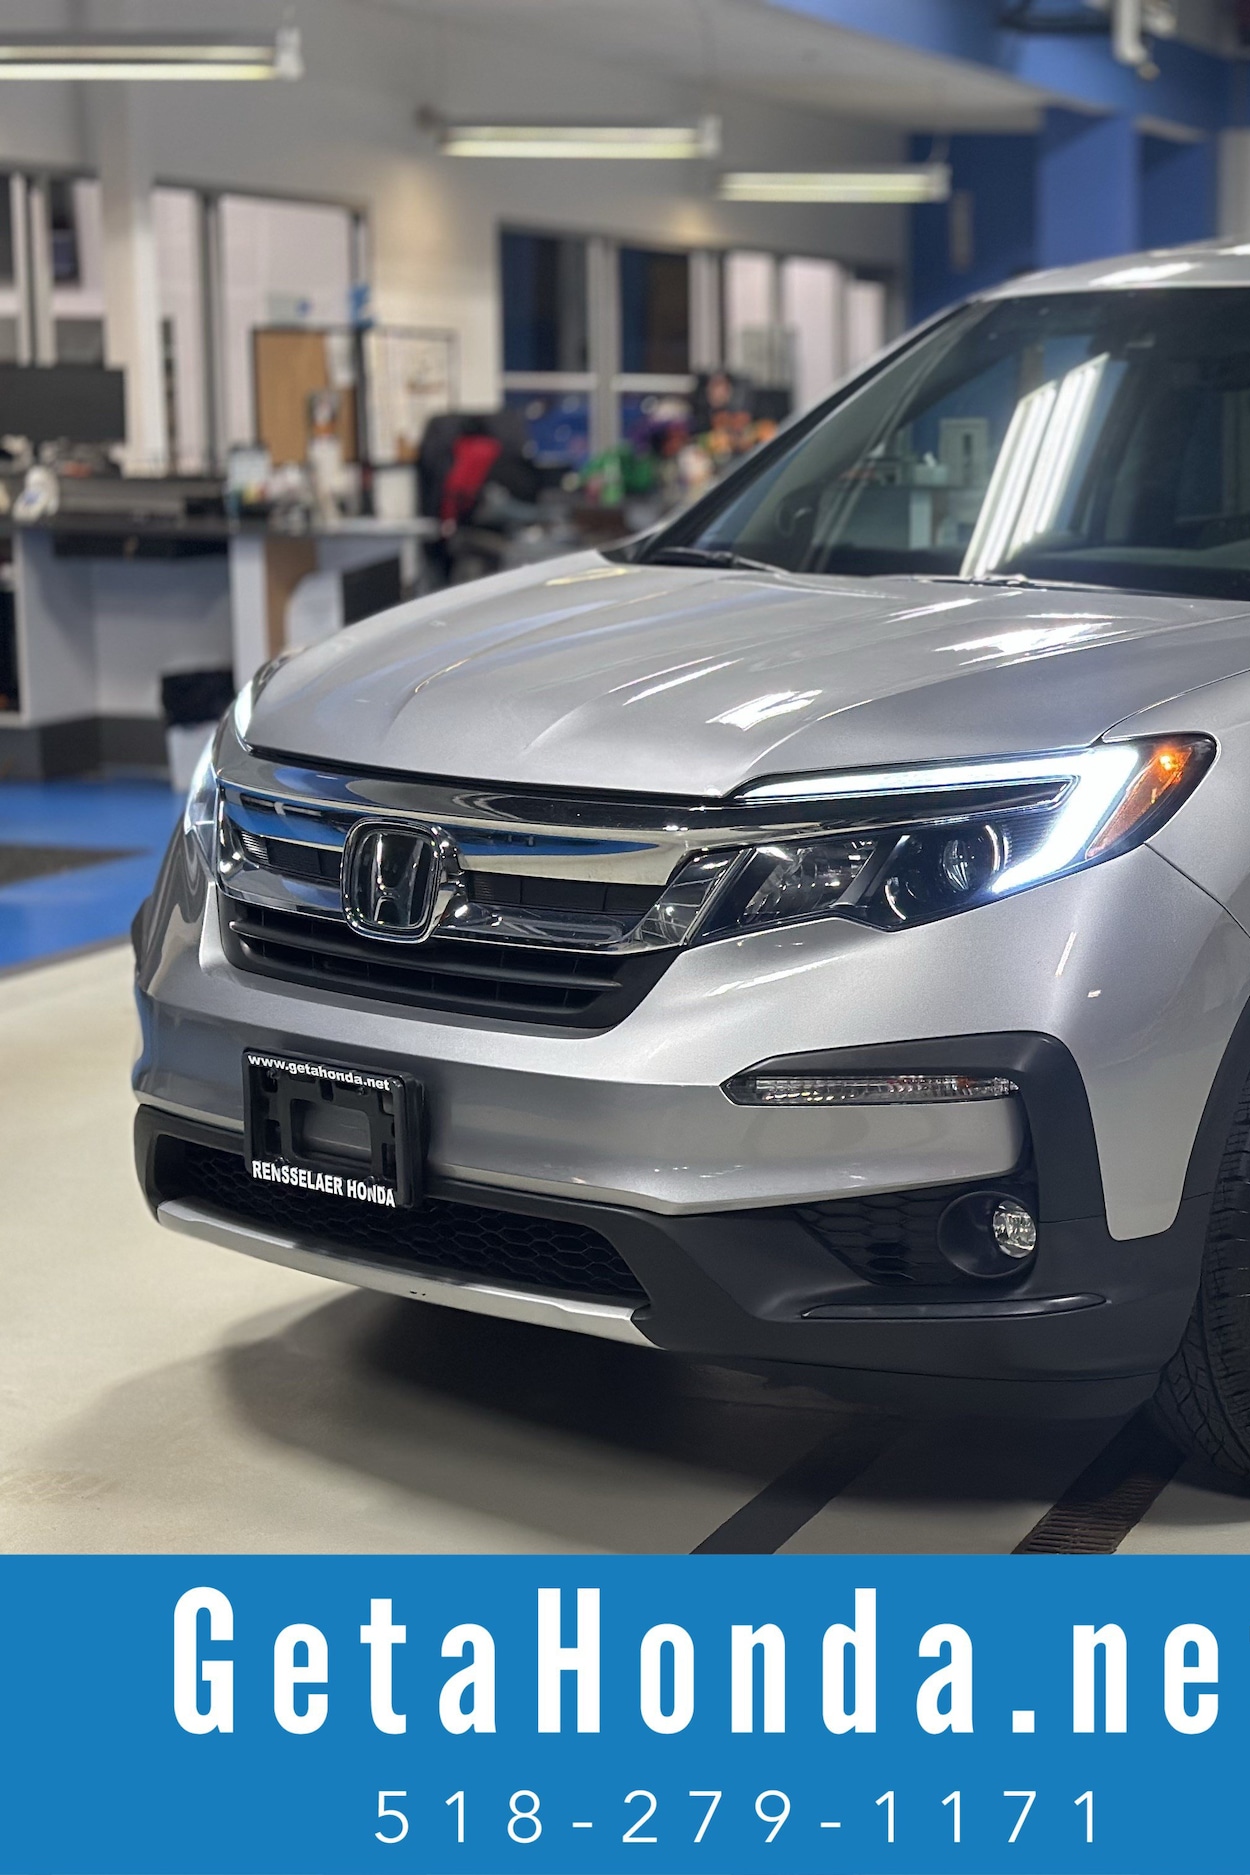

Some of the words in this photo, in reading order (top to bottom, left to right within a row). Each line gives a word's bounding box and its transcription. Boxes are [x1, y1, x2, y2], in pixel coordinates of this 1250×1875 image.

[248, 1055, 390, 1091] www.getahonda.net
[252, 1160, 343, 1196] RENSSELAER
[346, 1179, 396, 1208] HONDA
